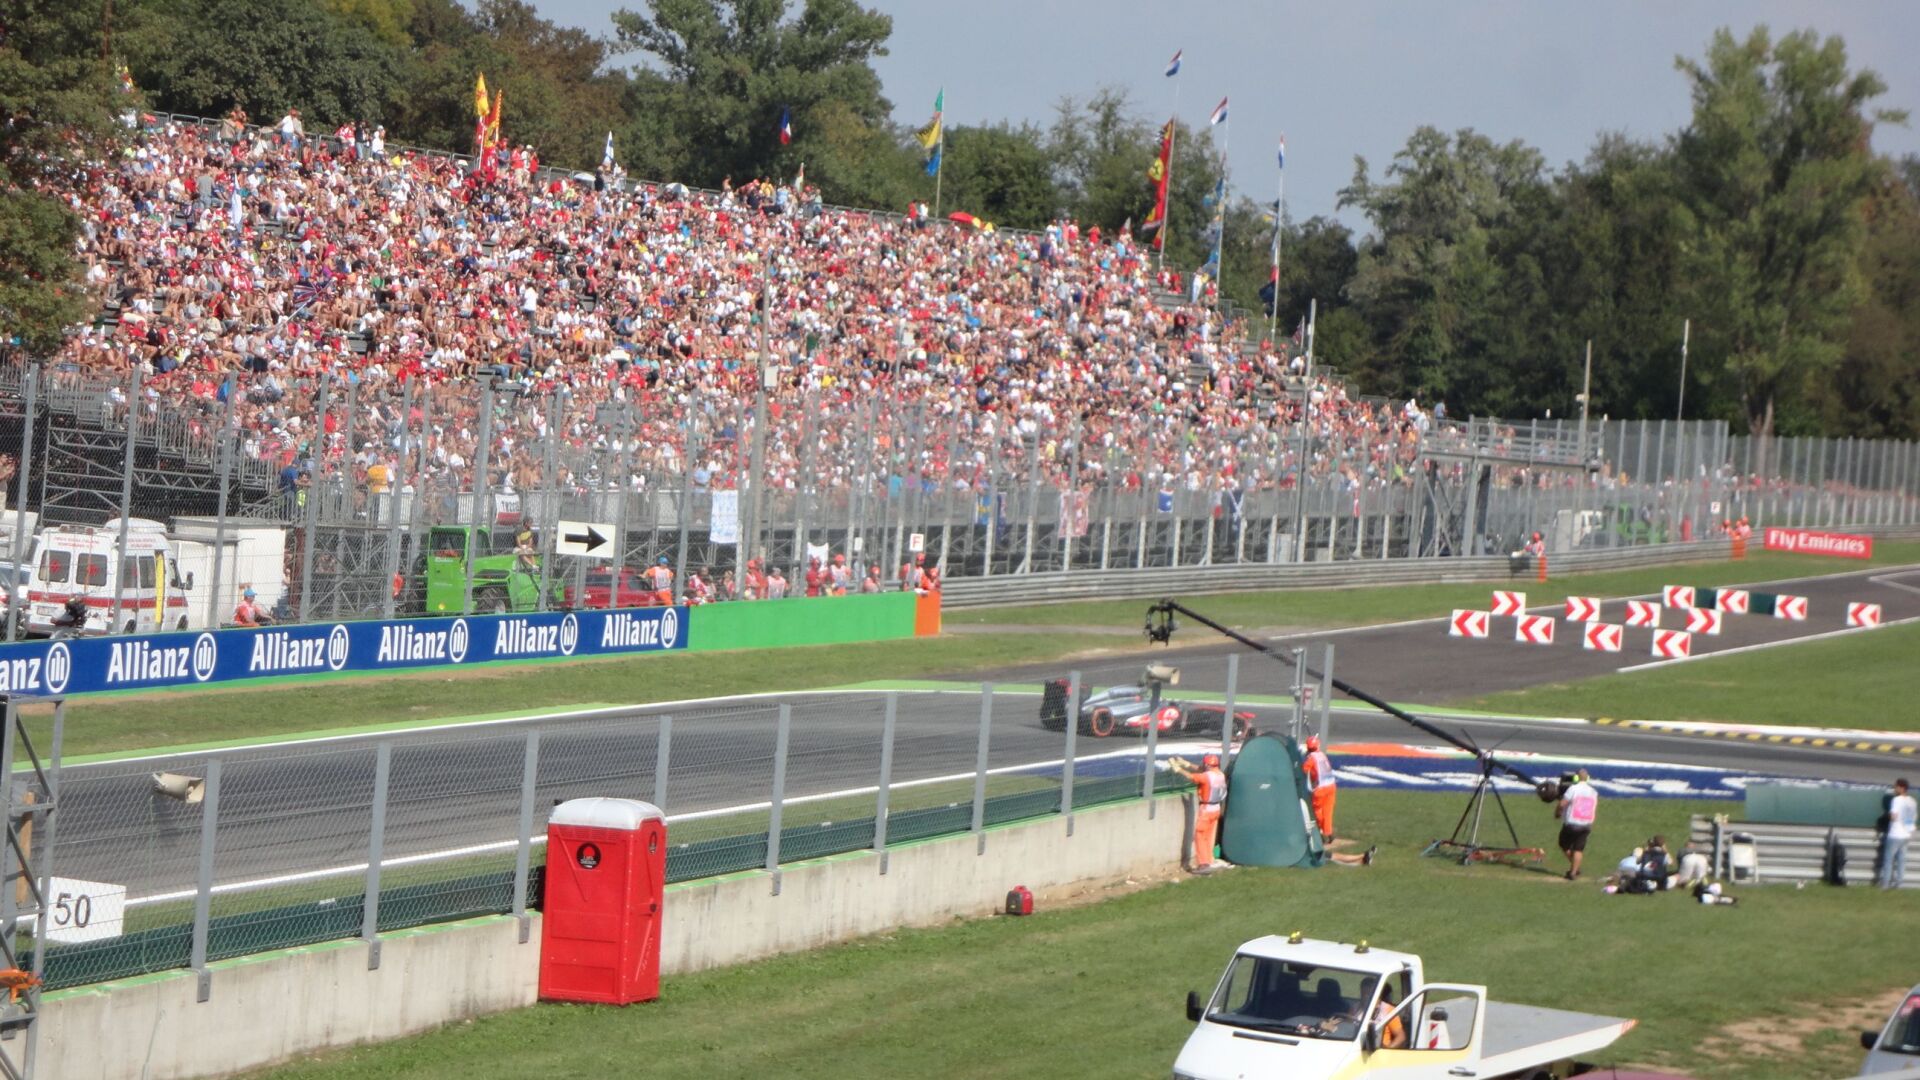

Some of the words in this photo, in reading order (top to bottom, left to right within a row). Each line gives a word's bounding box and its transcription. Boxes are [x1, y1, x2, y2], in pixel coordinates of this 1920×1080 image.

[912, 535, 921, 548] F
[1769, 530, 1797, 549] Fly
[1800, 533, 1865, 554] Emirates
[377, 625, 447, 662] Allianz
[494, 619, 558, 654] Allianz
[601, 613, 660, 648] Allianz
[106, 640, 190, 683] Allianz
[250, 631, 325, 671] Allianz
[54, 892, 91, 928] 50
